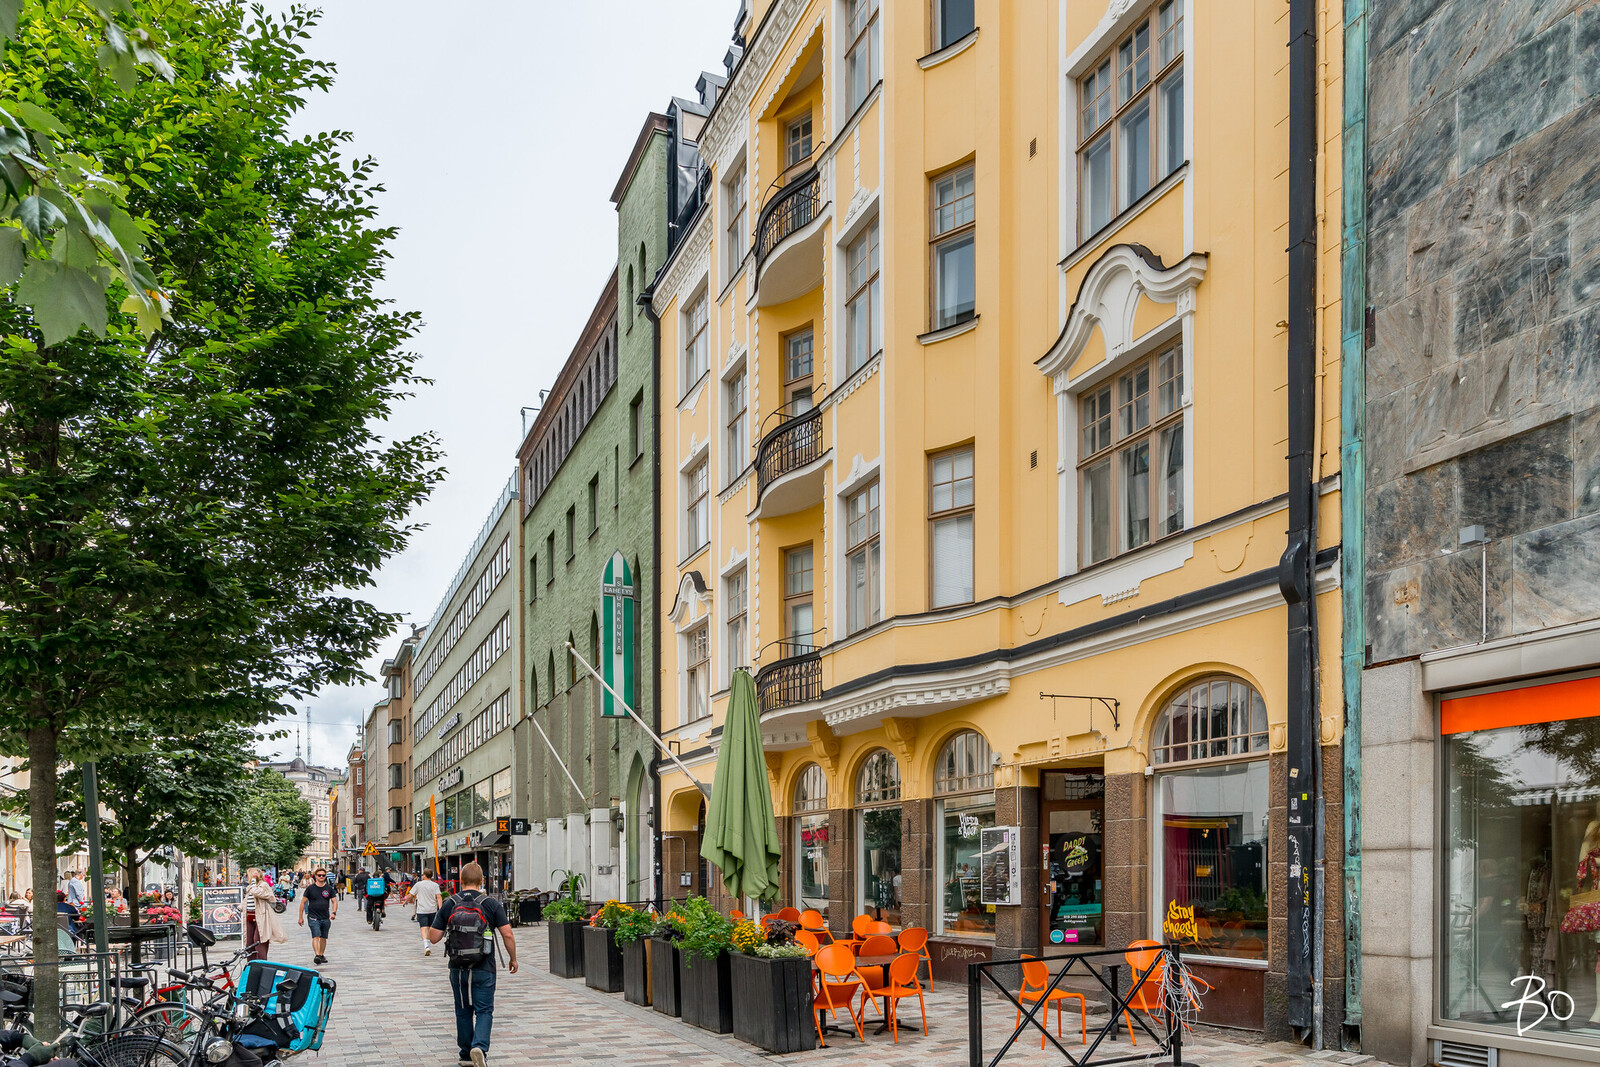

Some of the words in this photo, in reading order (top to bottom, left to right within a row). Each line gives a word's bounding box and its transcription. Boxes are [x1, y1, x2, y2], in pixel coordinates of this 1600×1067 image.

[1063, 836, 1086, 852] DADDY
[1169, 899, 1195, 924] Stay
[1163, 910, 1199, 943] cheesy
